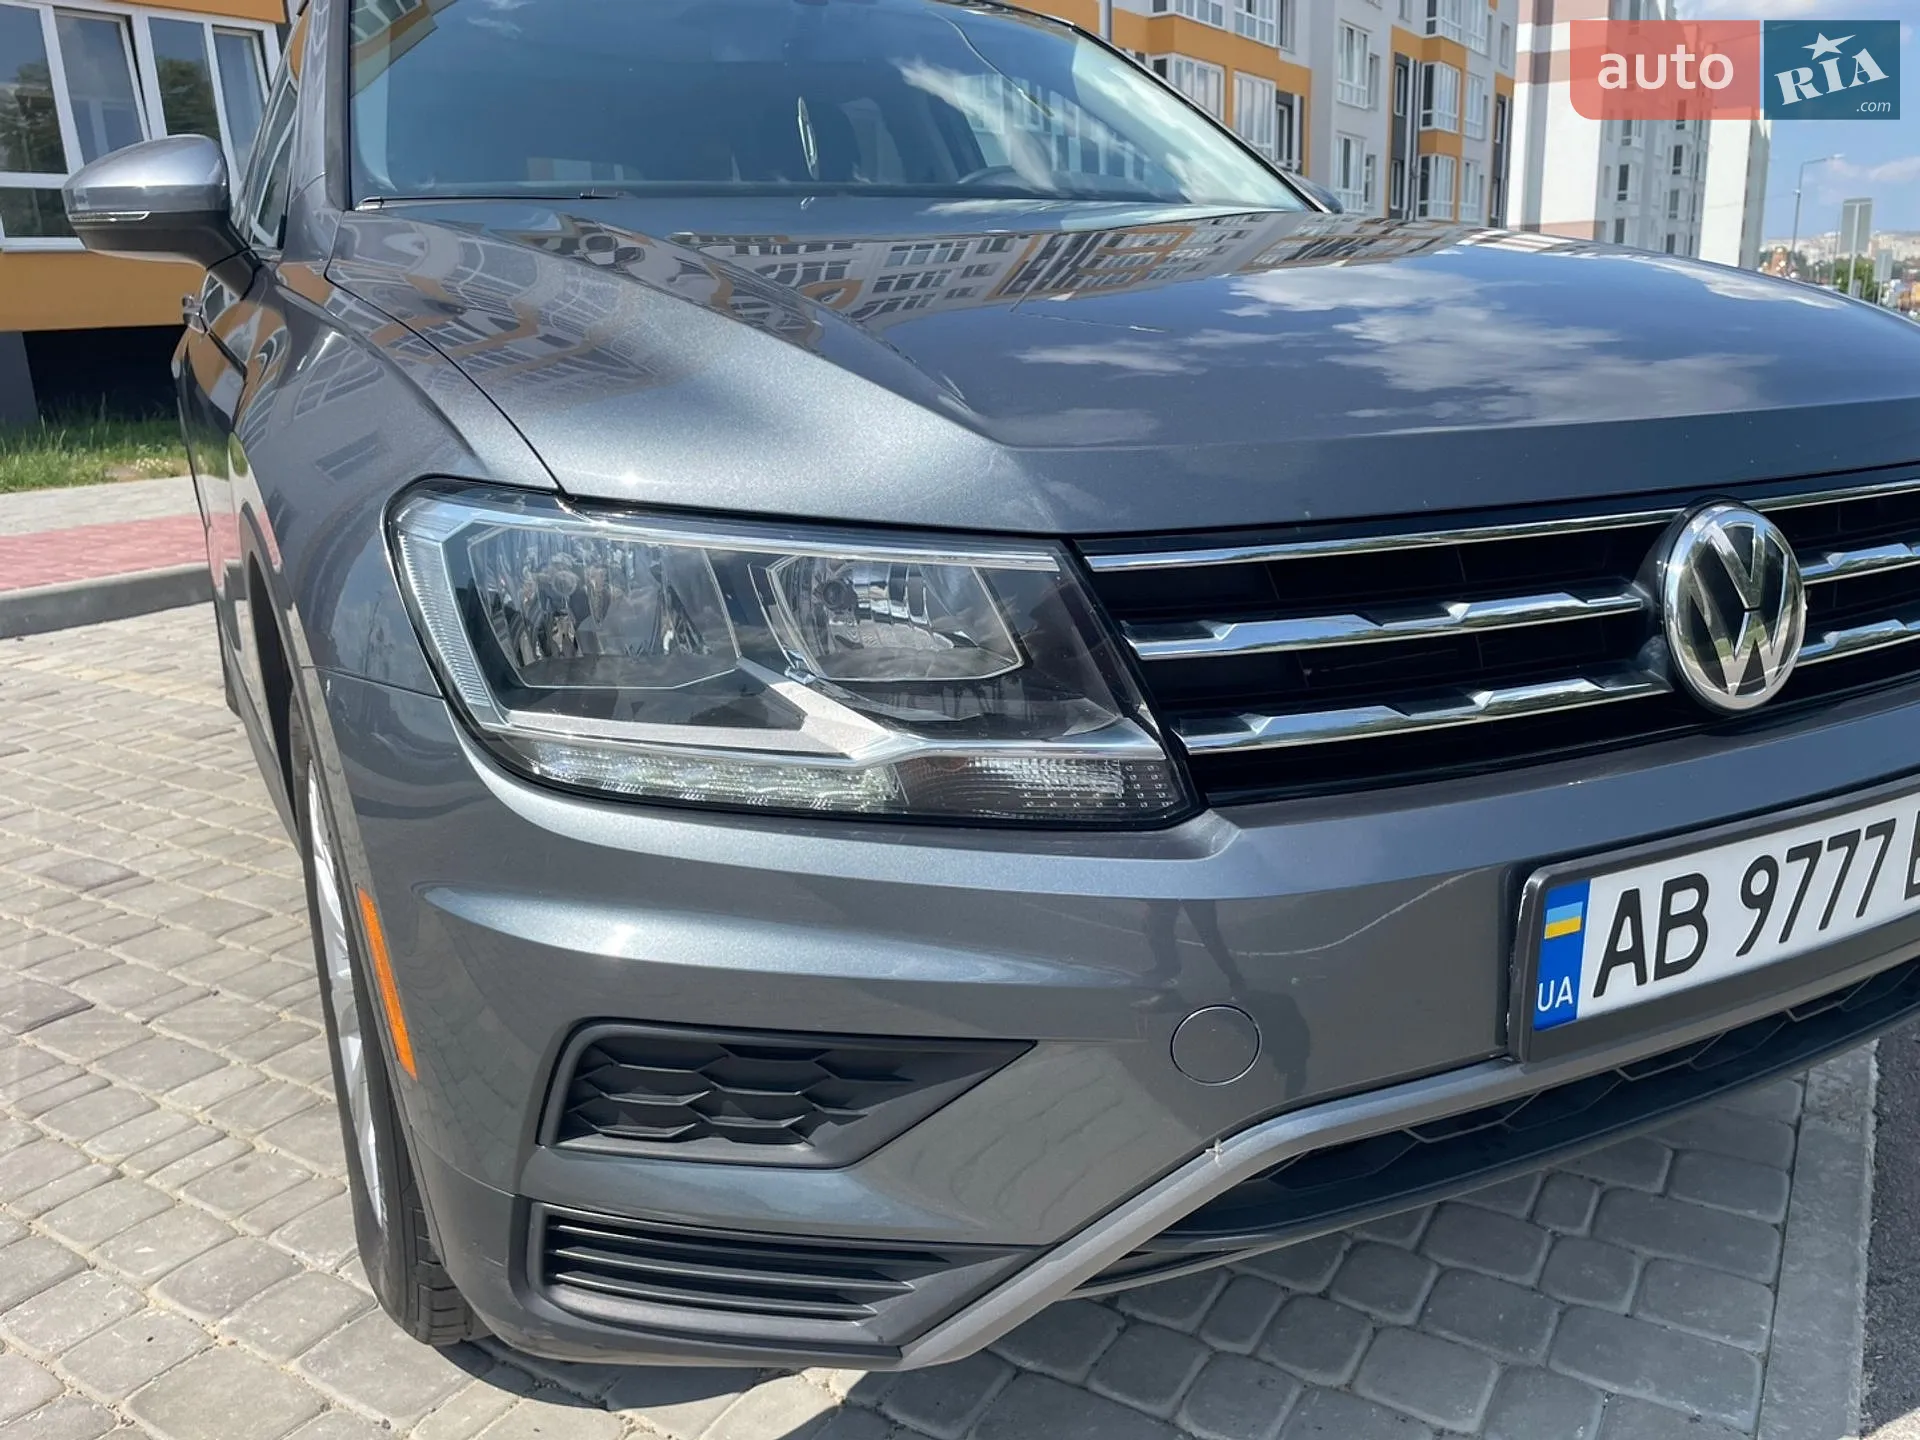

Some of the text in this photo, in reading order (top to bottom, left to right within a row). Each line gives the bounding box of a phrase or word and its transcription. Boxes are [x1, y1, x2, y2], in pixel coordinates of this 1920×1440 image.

[1593, 872, 1709, 999] AB
[1736, 818, 1897, 958] 9777
[1537, 975, 1573, 1012] UA
